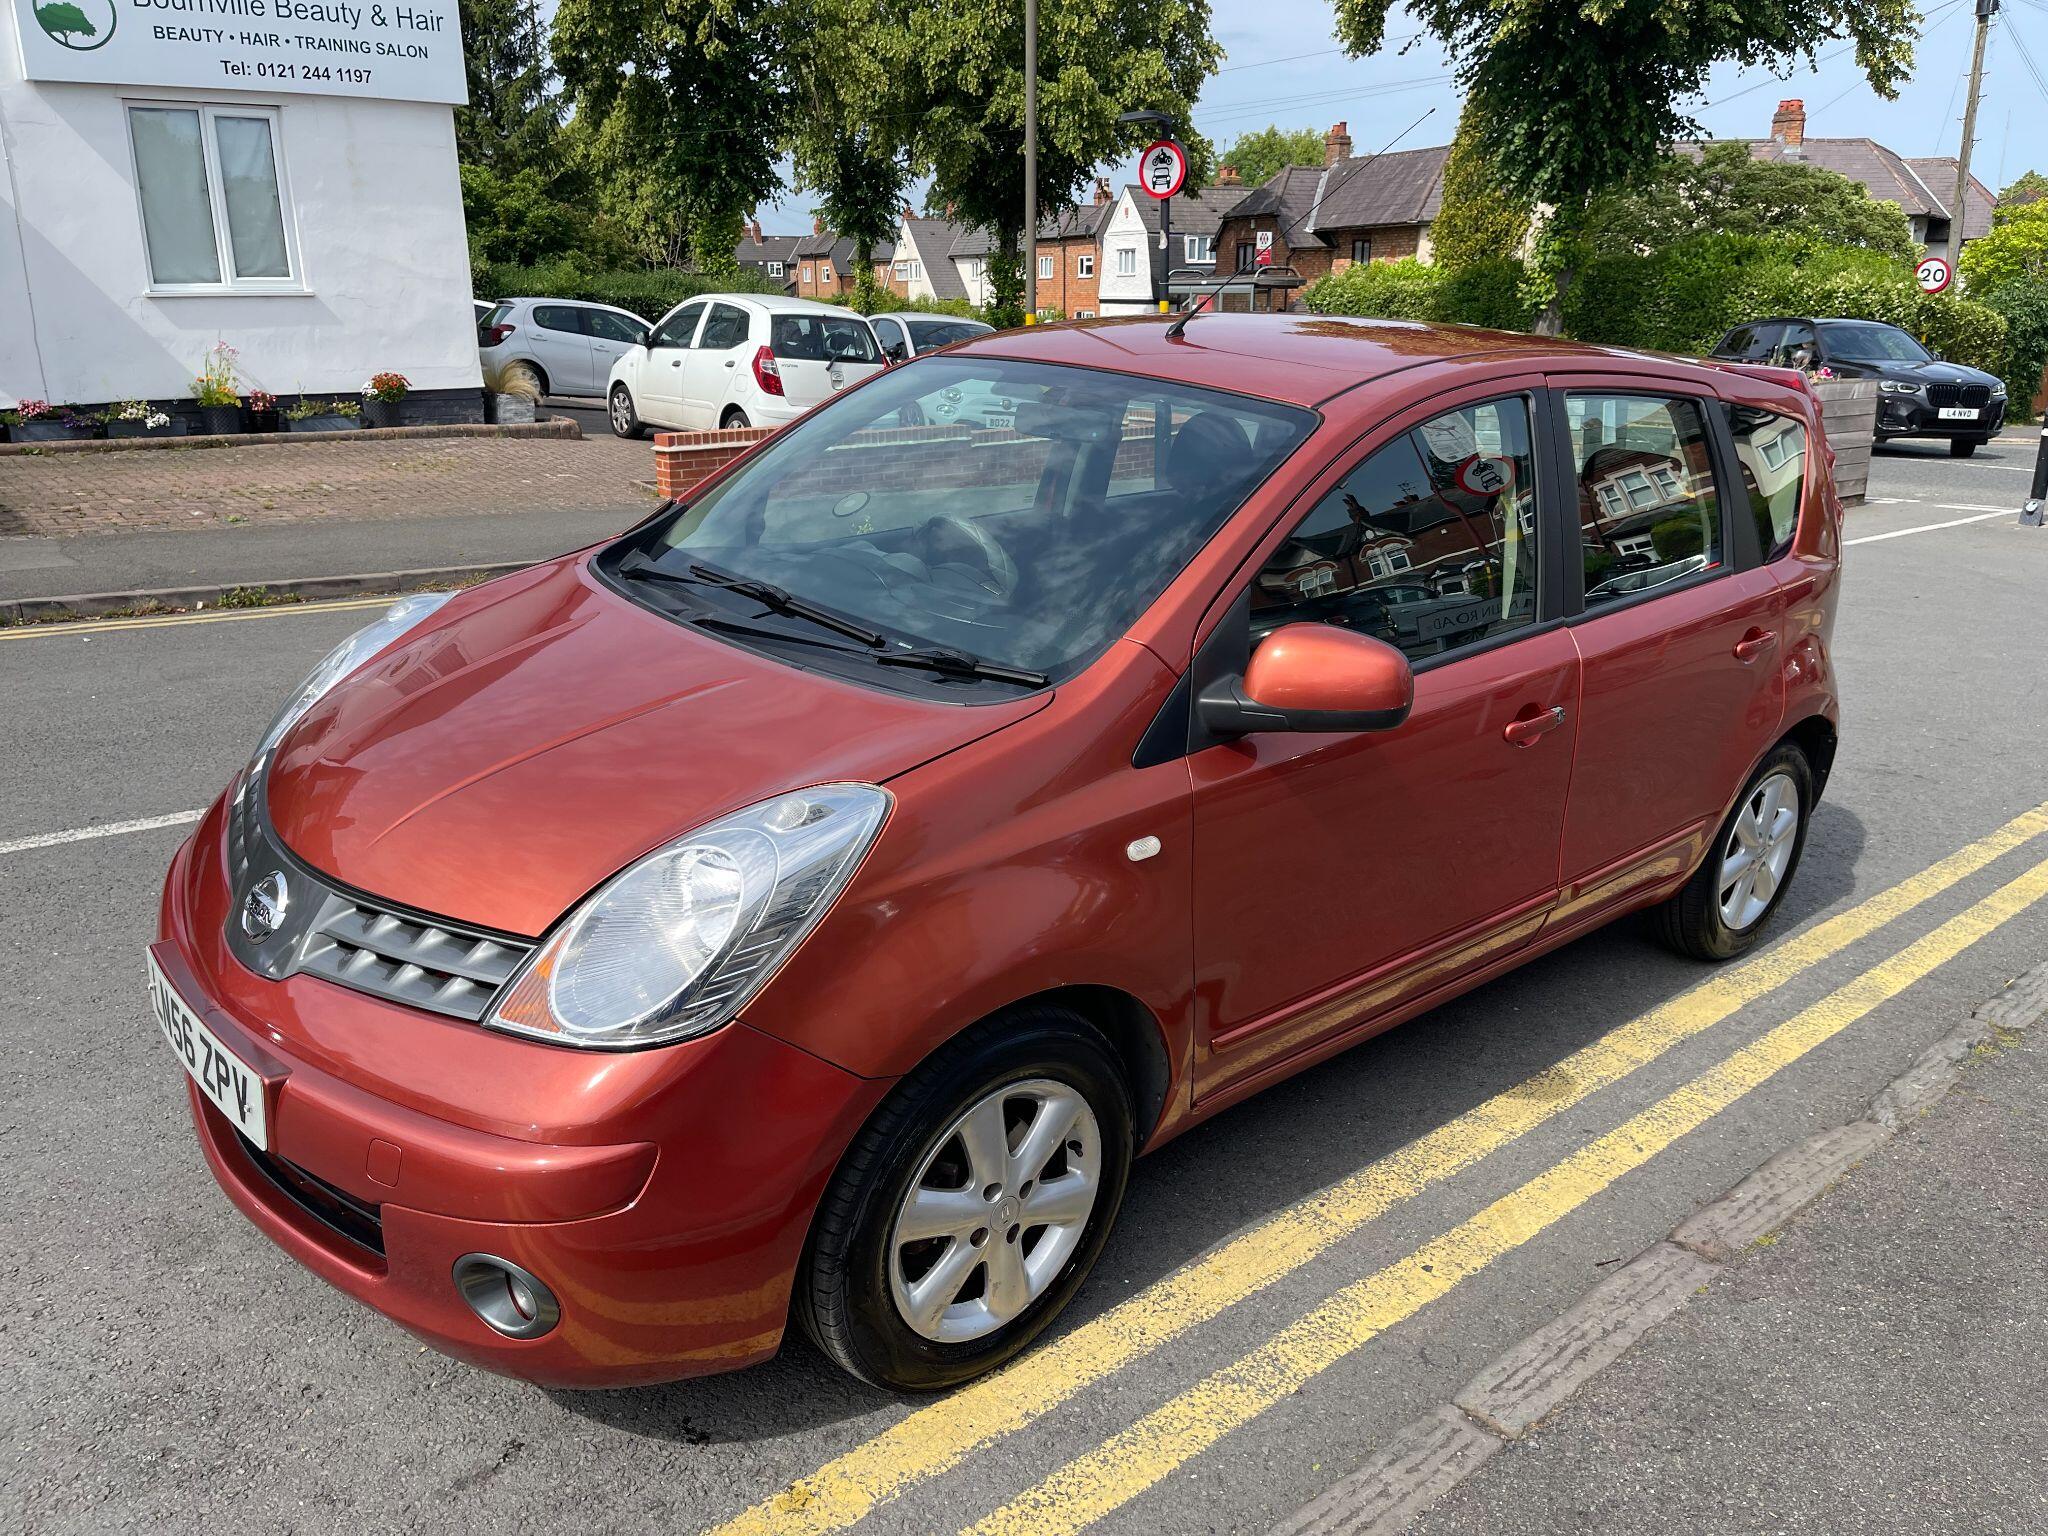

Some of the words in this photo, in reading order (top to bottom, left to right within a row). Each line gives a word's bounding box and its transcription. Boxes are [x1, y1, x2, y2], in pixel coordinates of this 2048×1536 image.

[275, 0, 361, 30] Beauty
[371, 4, 388, 27] &
[396, 6, 444, 32] Hair
[153, 26, 224, 43] BEAUTY
[240, 32, 281, 47] HAIR
[295, 36, 371, 54] TRAINING
[376, 42, 429, 59] SALON
[220, 60, 251, 76] Tel:
[257, 63, 295, 78] 0121
[302, 65, 331, 81] 244
[336, 68, 371, 84] 1197
[1920, 268, 1945, 283] 20
[1947, 410, 1956, 418] L4
[199, 1032, 248, 1125] ZPV
